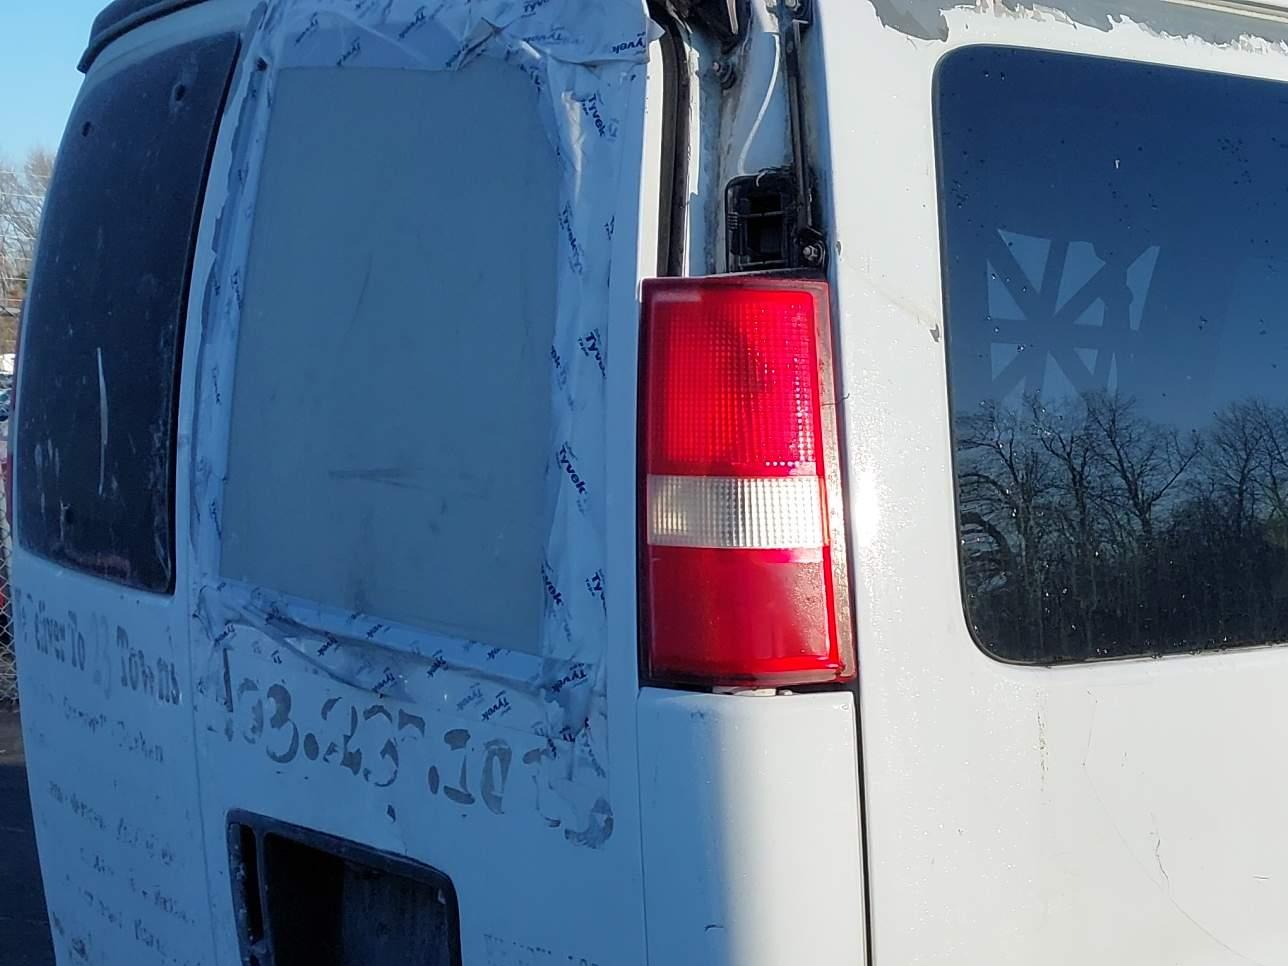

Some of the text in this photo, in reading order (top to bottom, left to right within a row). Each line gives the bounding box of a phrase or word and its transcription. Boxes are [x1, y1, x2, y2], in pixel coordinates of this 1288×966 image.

[587, 93, 606, 137] Tyvek
[559, 443, 588, 495] Tyvek
[551, 667, 588, 693] Tyvek
[480, 695, 510, 722] Tyvek
